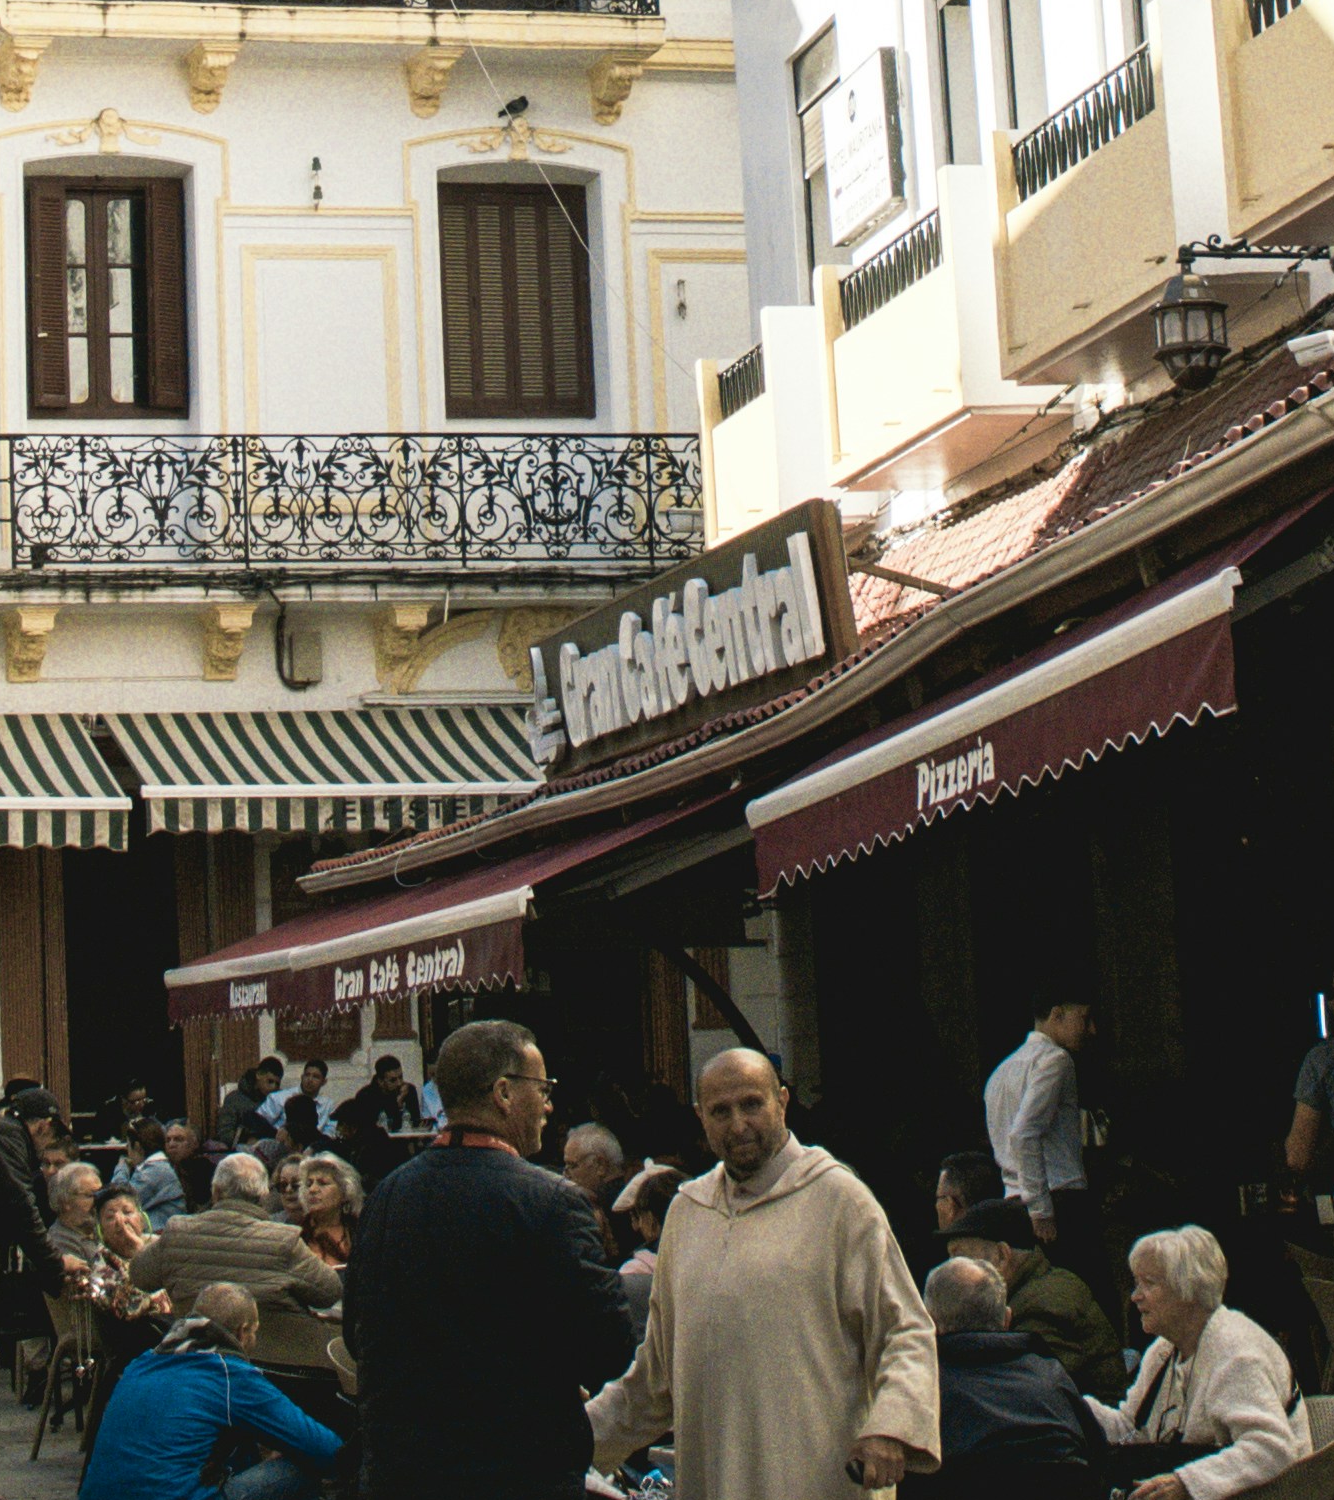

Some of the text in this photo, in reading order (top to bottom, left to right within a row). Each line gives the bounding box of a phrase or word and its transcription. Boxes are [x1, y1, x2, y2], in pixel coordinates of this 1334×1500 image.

[559, 531, 826, 748] Gran Café Central
[915, 735, 996, 812] Pizzeria
[334, 938, 465, 1001] Gran Café Central
